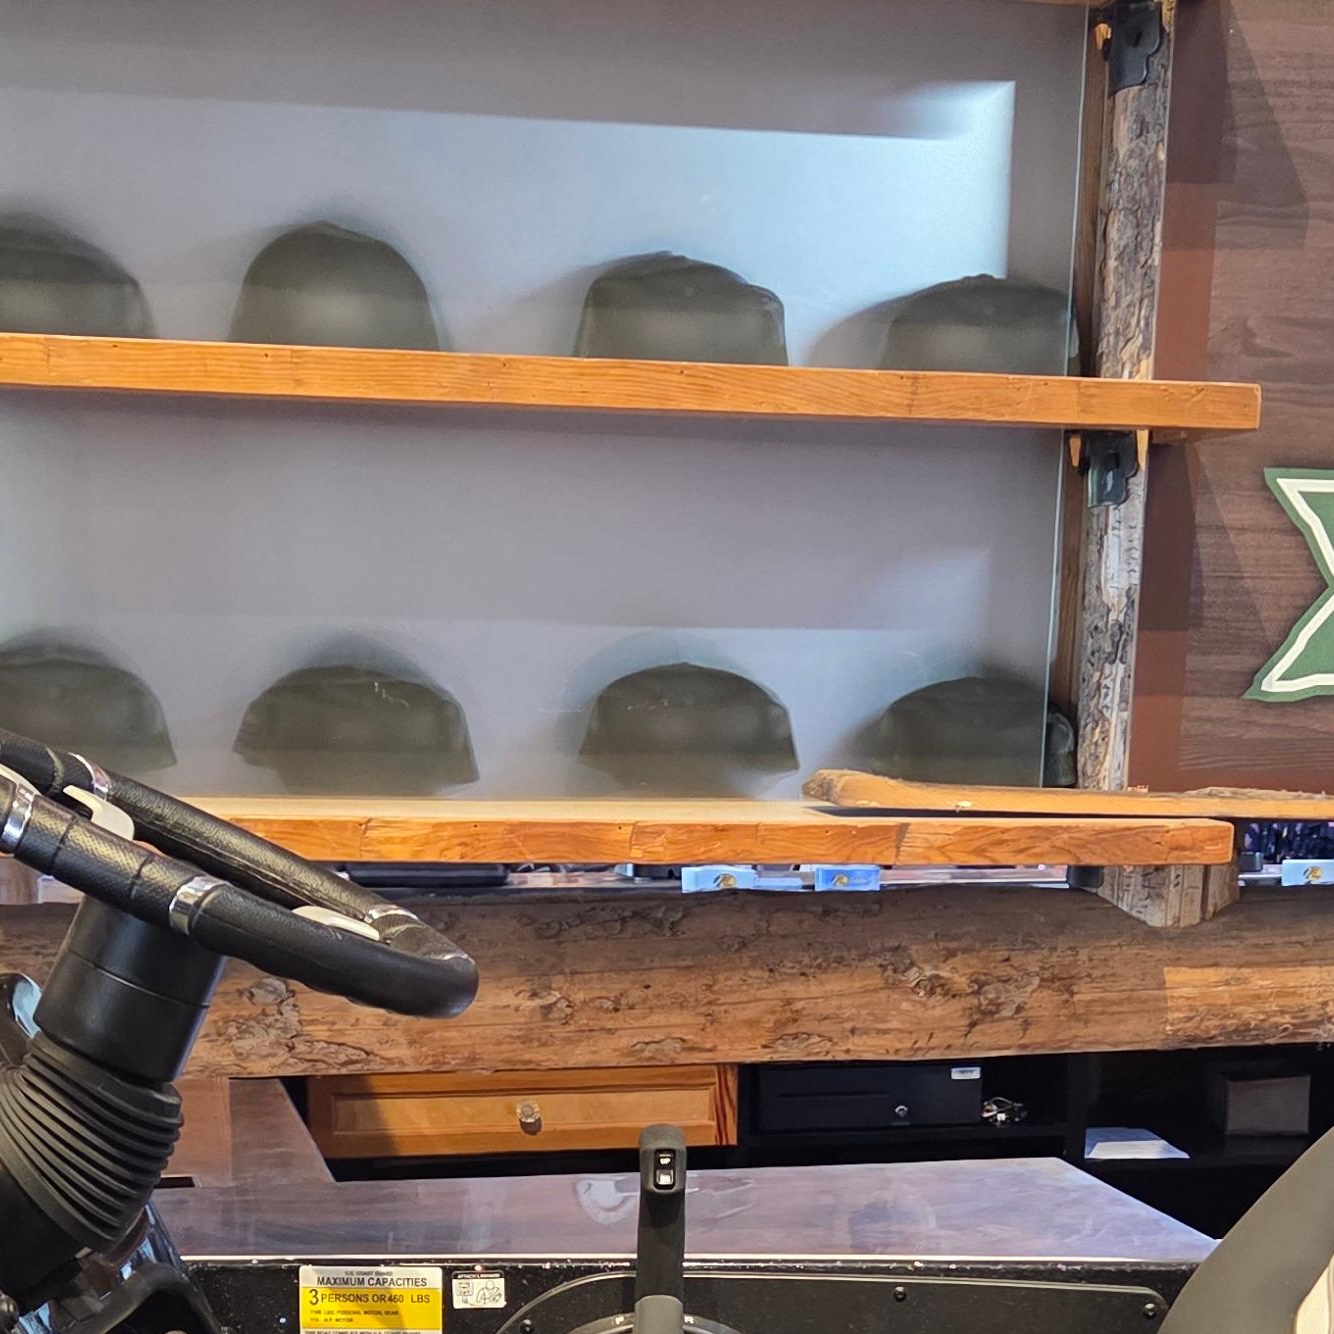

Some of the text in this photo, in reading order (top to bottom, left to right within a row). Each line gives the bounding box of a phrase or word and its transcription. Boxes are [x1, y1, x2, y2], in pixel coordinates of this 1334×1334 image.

[316, 1277, 427, 1287] MAXIMUM CAPACITIES
[309, 1288, 319, 1306] 3
[321, 1293, 370, 1303] PERSONS
[371, 1293, 386, 1303] OR
[410, 1294, 431, 1303] LBS
